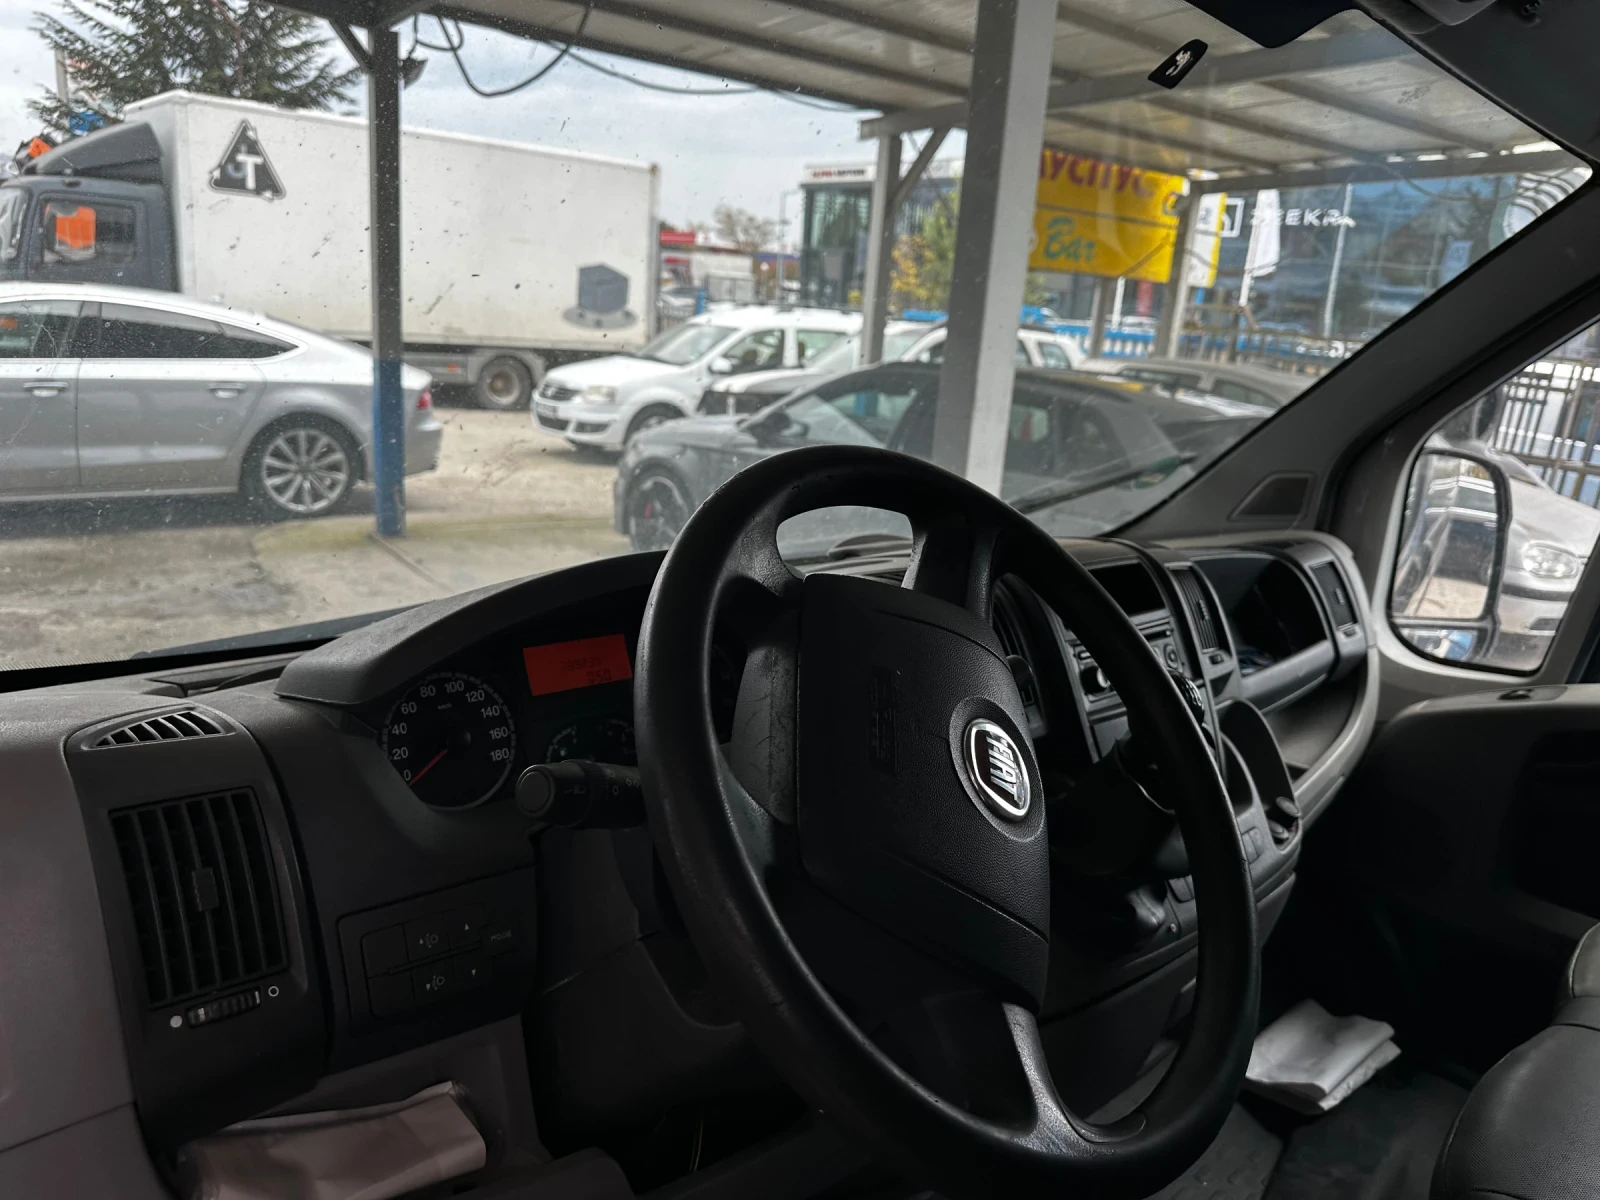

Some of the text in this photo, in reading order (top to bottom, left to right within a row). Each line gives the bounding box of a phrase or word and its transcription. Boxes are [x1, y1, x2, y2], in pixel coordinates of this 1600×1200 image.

[420, 685, 436, 698] 80
[444, 681, 465, 693] 100
[465, 690, 485, 703] 120
[401, 702, 417, 715] 60
[480, 705, 500, 719] 140
[391, 722, 408, 736] 40
[489, 726, 509, 740] 160
[392, 746, 409, 760] 20
[490, 748, 510, 762] 180
[403, 770, 412, 782] 0
[985, 734, 1020, 804] FIAT
